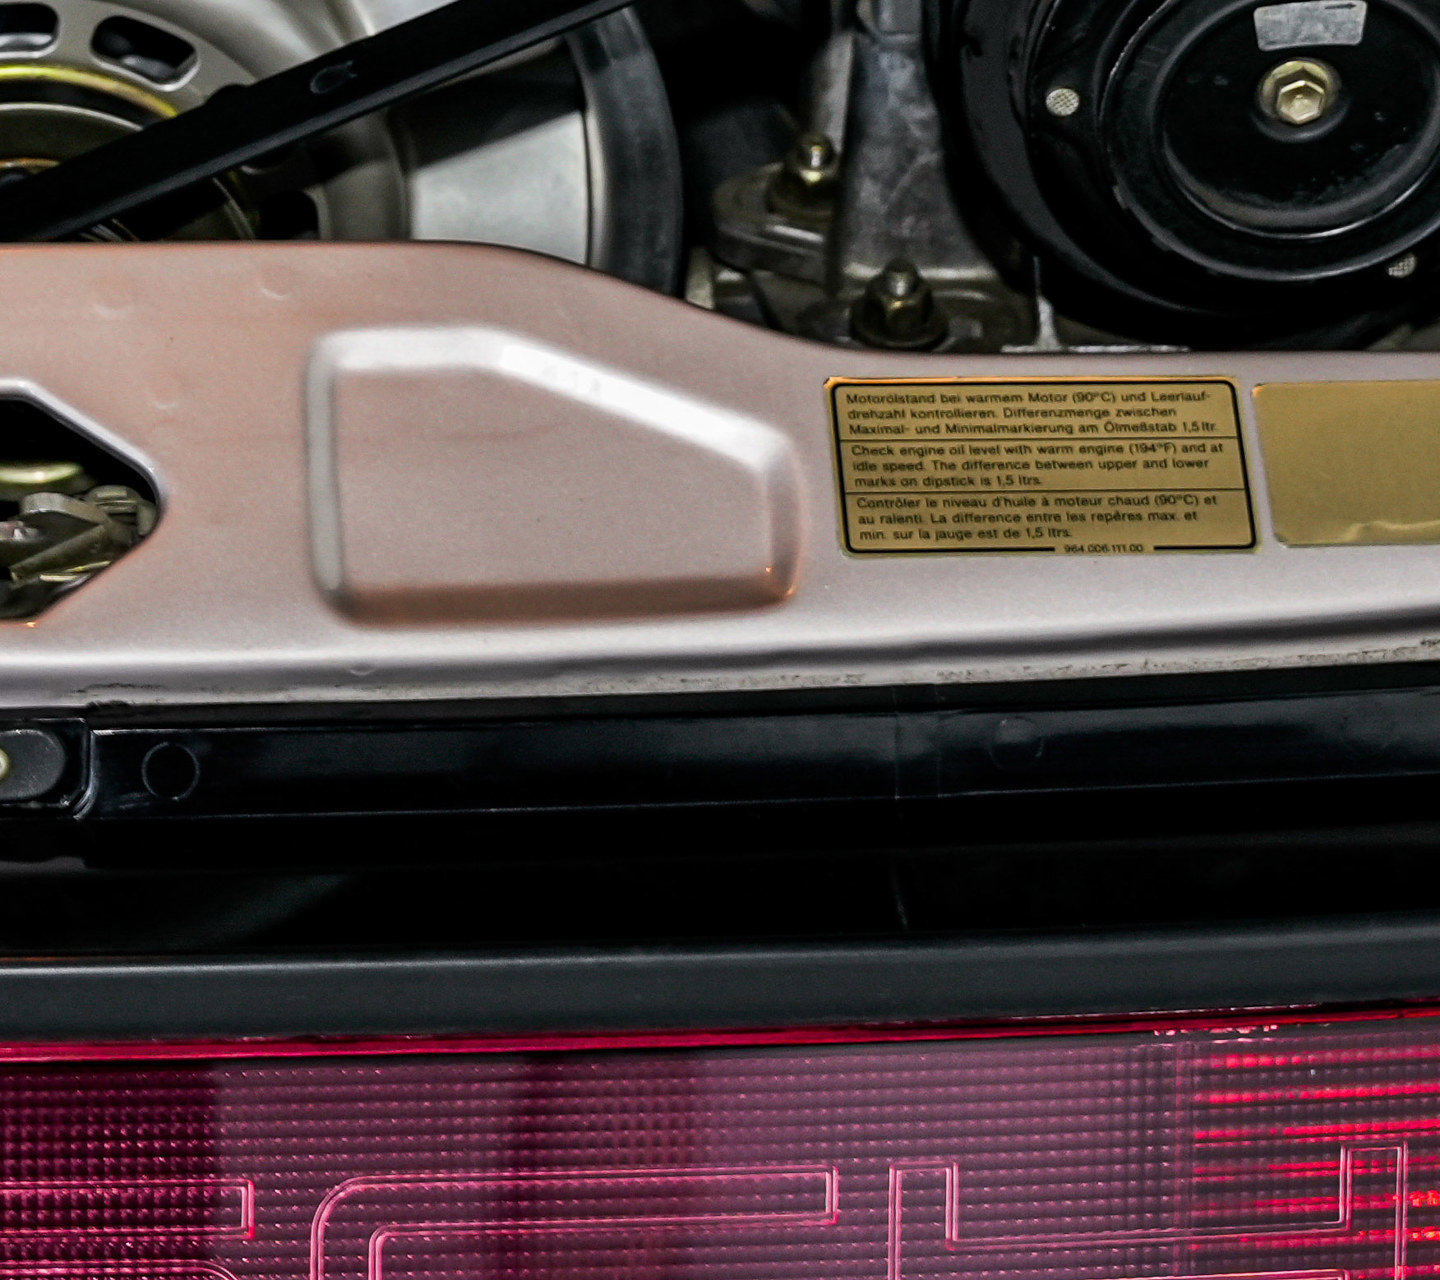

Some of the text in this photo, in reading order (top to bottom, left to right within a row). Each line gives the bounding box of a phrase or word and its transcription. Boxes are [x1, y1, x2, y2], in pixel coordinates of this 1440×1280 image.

[940, 393, 962, 404] bei
[966, 394, 1023, 404] warmem
[1028, 392, 1068, 403] Motor
[1121, 391, 1150, 402] und
[848, 409, 906, 420] drehzahl
[1003, 407, 1111, 419] Differenzmenge
[1116, 407, 1177, 418] zwischen
[849, 423, 910, 435] Maximal-
[915, 423, 941, 434] und
[945, 422, 1073, 435] Minimalmarkierung
[1078, 424, 1099, 433] am
[851, 444, 895, 456] Check
[899, 445, 945, 459] engine
[949, 444, 964, 456] oil
[969, 444, 1000, 456] level
[1004, 443, 1032, 456] with
[1037, 444, 1073, 454] warm
[1078, 443, 1124, 457] engine
[1181, 442, 1206, 453] and
[1210, 443, 1223, 453] at
[853, 460, 877, 472] idle
[931, 459, 958, 471] The
[961, 459, 1030, 471] difference
[1035, 458, 1093, 470] between
[1098, 459, 1139, 472] upper
[1142, 458, 1168, 469] and
[1172, 458, 1210, 469] lower
[855, 475, 896, 487] marks
[900, 476, 918, 486] on
[922, 475, 978, 488] dipstick
[981, 475, 992, 486] is
[925, 497, 938, 508] le
[942, 497, 987, 508] niveau
[991, 496, 1036, 508] d'huile
[1054, 495, 1102, 507] moteur
[1107, 494, 1150, 506] chaud
[1203, 495, 1217, 505] et
[858, 514, 875, 524] au
[930, 513, 948, 524] La
[1026, 512, 1063, 523] entre
[1066, 511, 1087, 522] les
[1183, 511, 1198, 521] et
[893, 529, 914, 540] sur
[918, 528, 931, 539] la
[935, 528, 973, 542] jauge
[977, 528, 998, 539] est
[1003, 528, 1020, 539] de
